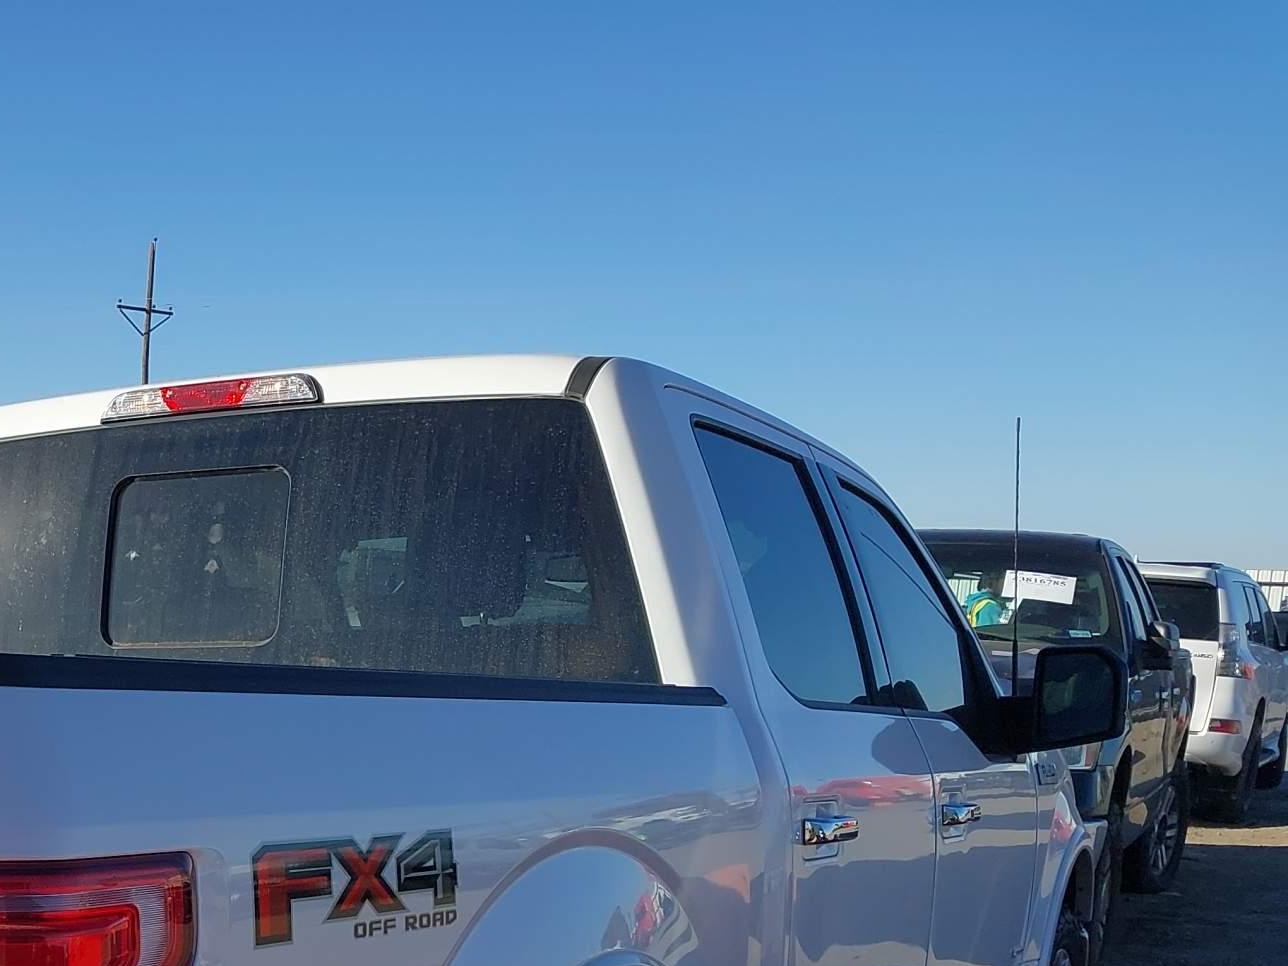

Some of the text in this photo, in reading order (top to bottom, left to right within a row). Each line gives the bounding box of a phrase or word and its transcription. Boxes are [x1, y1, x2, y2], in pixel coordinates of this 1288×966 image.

[251, 828, 458, 949] FX4
[353, 909, 458, 939] OFF ROAD
